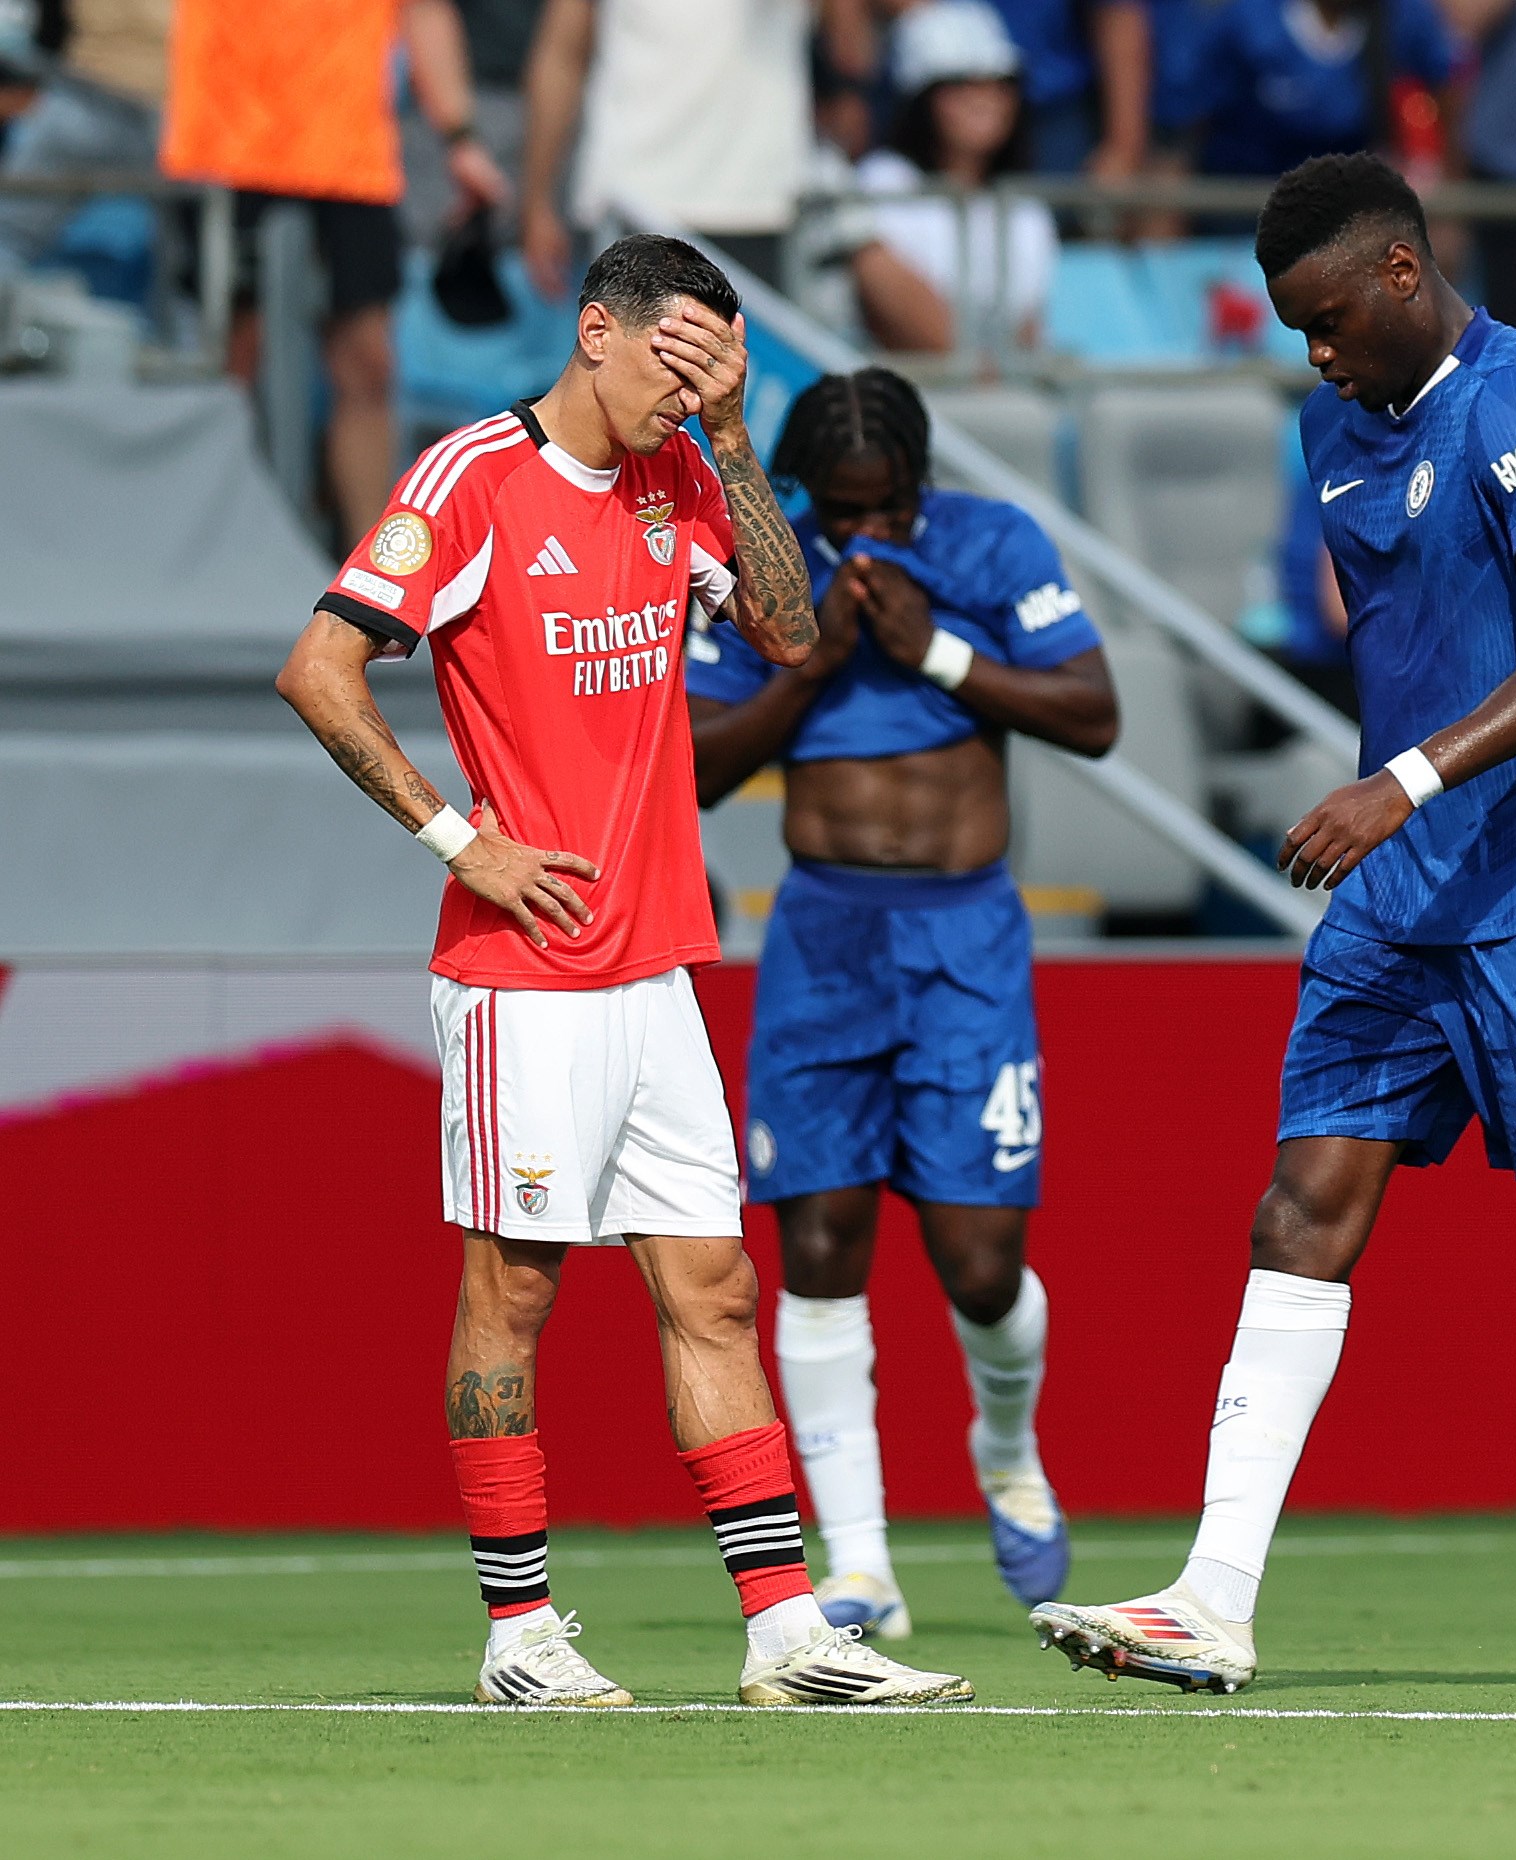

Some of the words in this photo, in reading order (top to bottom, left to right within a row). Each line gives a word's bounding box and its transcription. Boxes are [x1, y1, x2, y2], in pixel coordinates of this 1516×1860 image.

[384, 518, 412, 532] WORLD
[412, 524, 426, 539] CUP
[376, 554, 401, 571] FIFA
[573, 659, 606, 696] FLY
[609, 646, 668, 693] BETTR
[980, 1061, 1042, 1147] 45
[496, 1375, 524, 1400] 37
